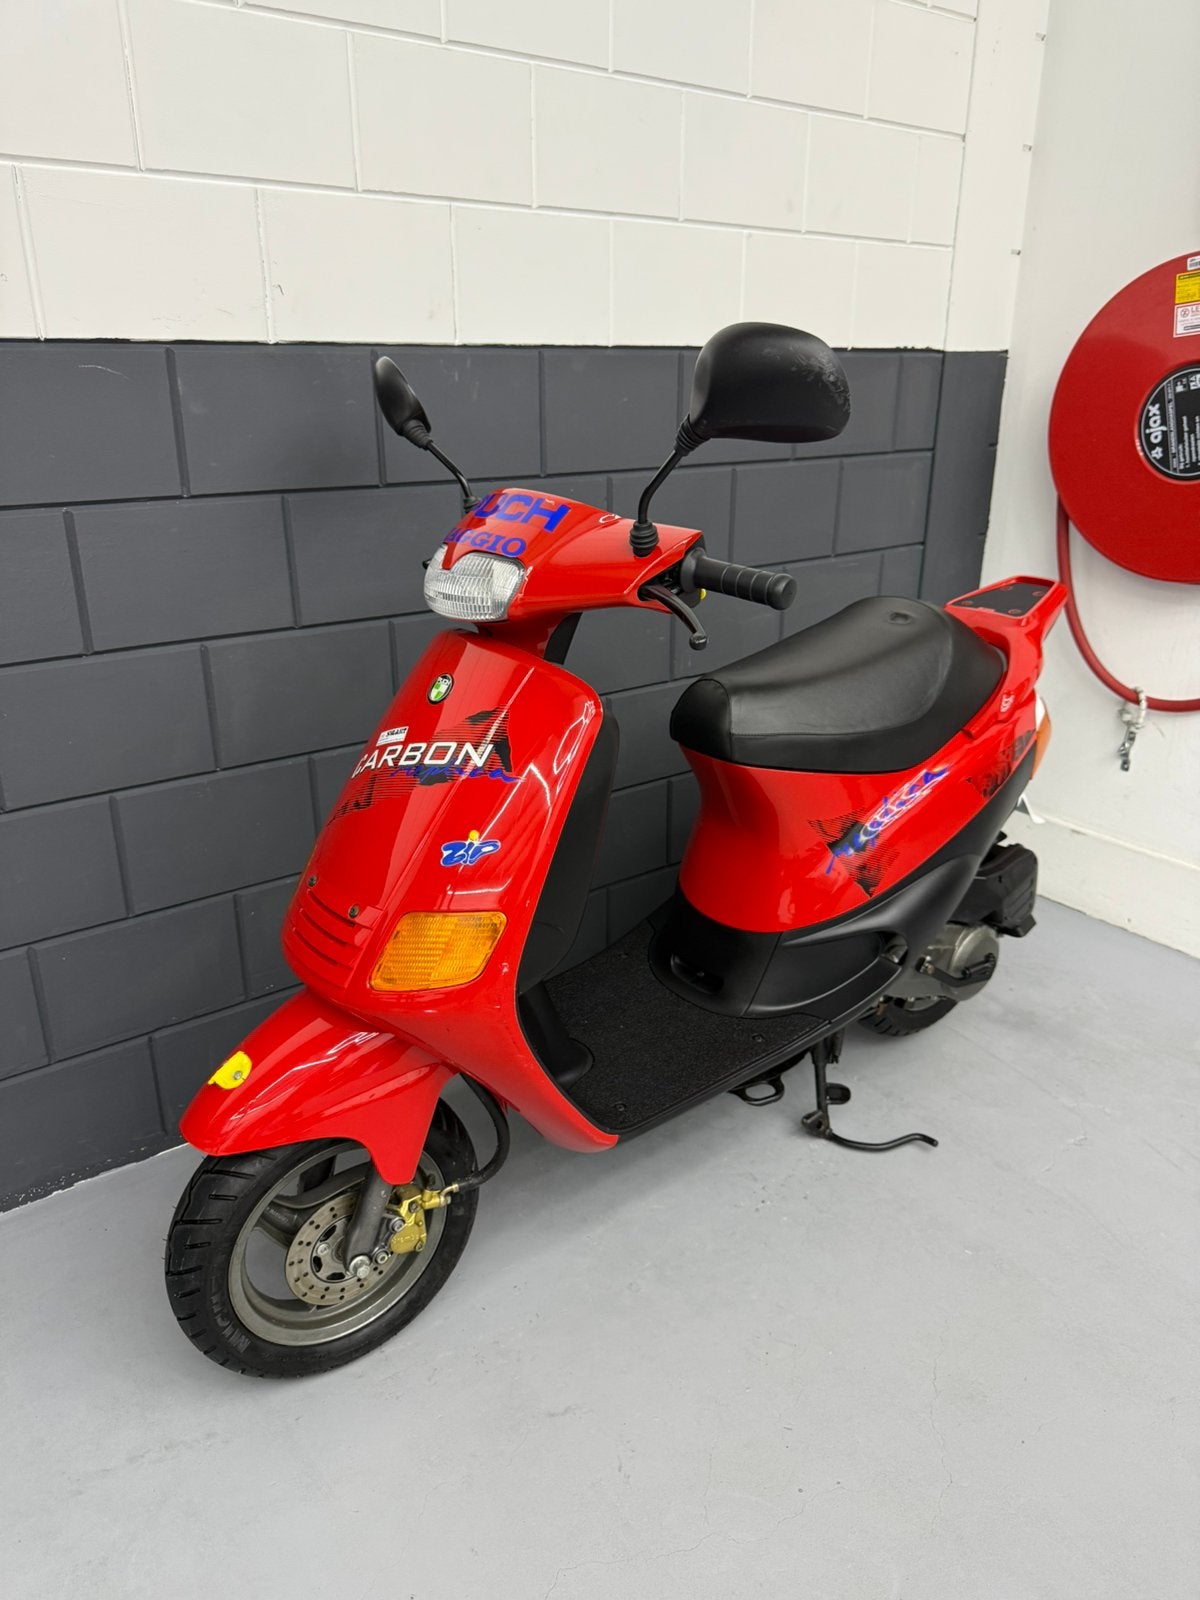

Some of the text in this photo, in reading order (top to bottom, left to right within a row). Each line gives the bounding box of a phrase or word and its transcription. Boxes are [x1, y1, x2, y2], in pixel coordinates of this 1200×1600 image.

[1144, 402, 1168, 444] ajax
[443, 526, 527, 558] AGGIO
[351, 741, 494, 779] CARBON
